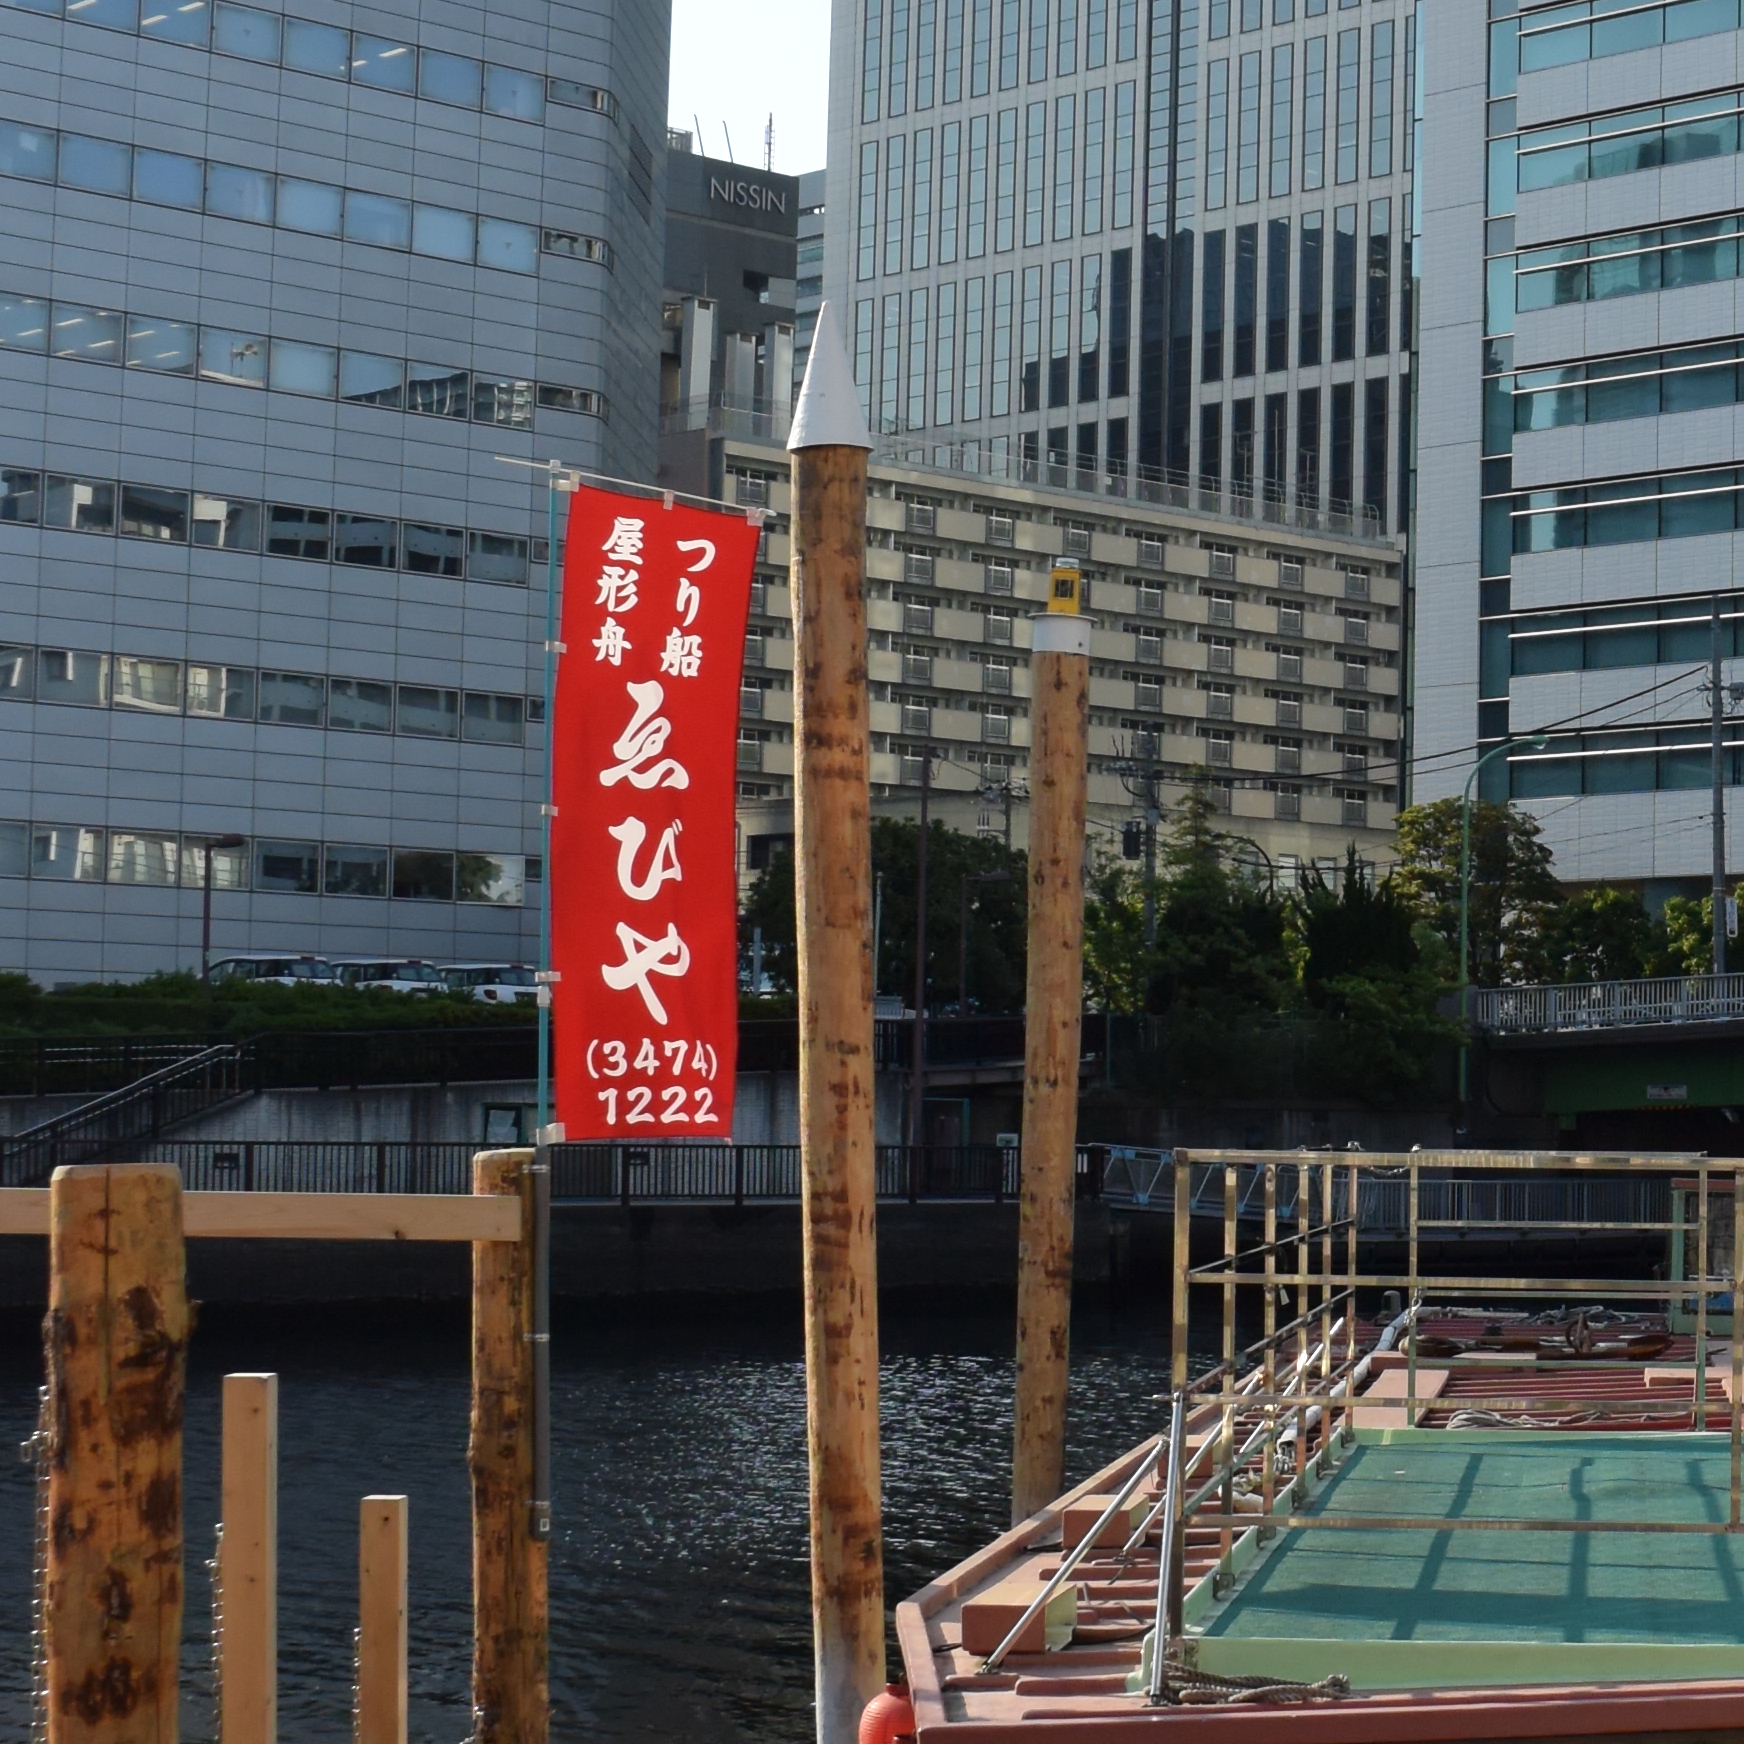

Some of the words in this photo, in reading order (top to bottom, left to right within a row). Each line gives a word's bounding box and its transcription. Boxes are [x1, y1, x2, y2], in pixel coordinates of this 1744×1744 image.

[710, 176, 786, 215] NISSIN
[591, 516, 645, 667] 屋形舟
[660, 537, 717, 678] つり船
[599, 679, 691, 1026] ゑびや
[586, 1037, 718, 1081] (3474)
[597, 1086, 719, 1125] 1222
